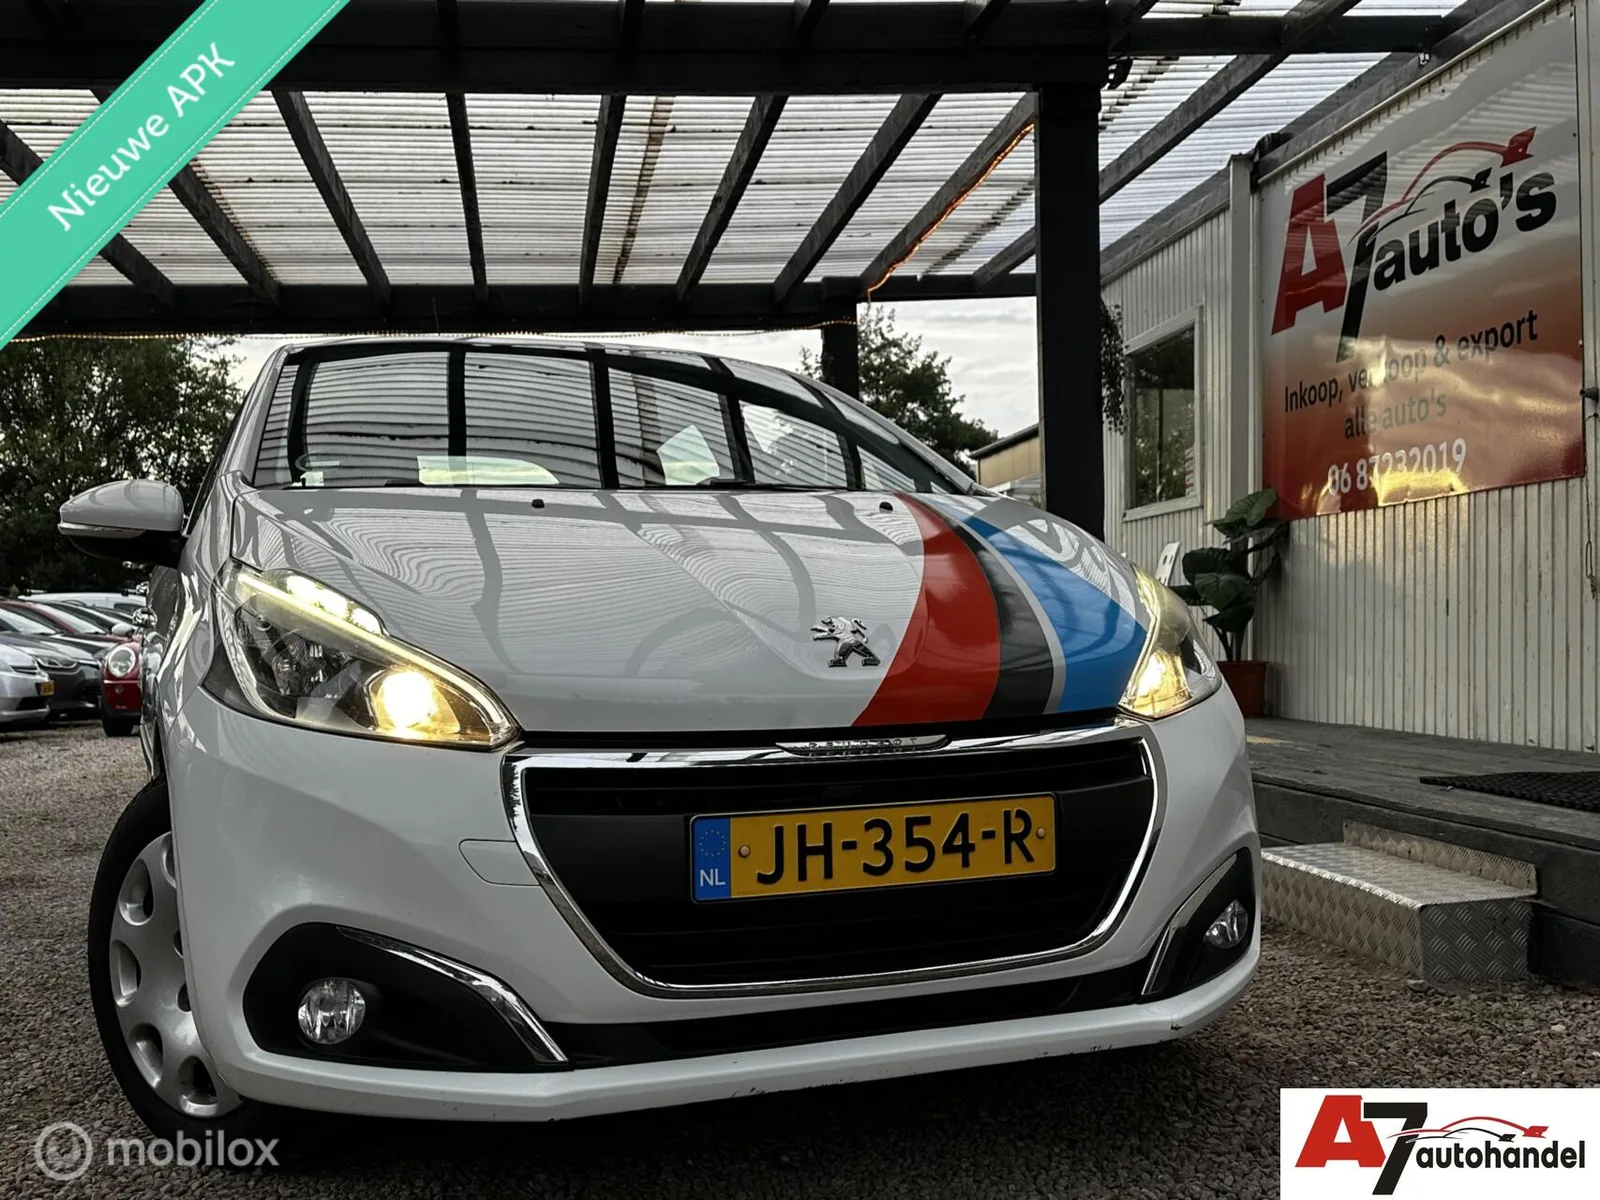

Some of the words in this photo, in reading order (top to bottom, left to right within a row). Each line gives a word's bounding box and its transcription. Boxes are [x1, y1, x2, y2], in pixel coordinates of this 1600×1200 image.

[1271, 151, 1388, 363] A7
[1373, 172, 1558, 291] auto's
[1285, 378, 1343, 413] Inkoop,
[1433, 334, 1451, 368] &
[1457, 309, 1538, 361] export
[1345, 406, 1377, 439] alle
[1383, 388, 1447, 429] auto's
[1328, 461, 1352, 496] 06
[700, 869, 726, 887] NL
[756, 808, 1035, 886] JH-354-R
